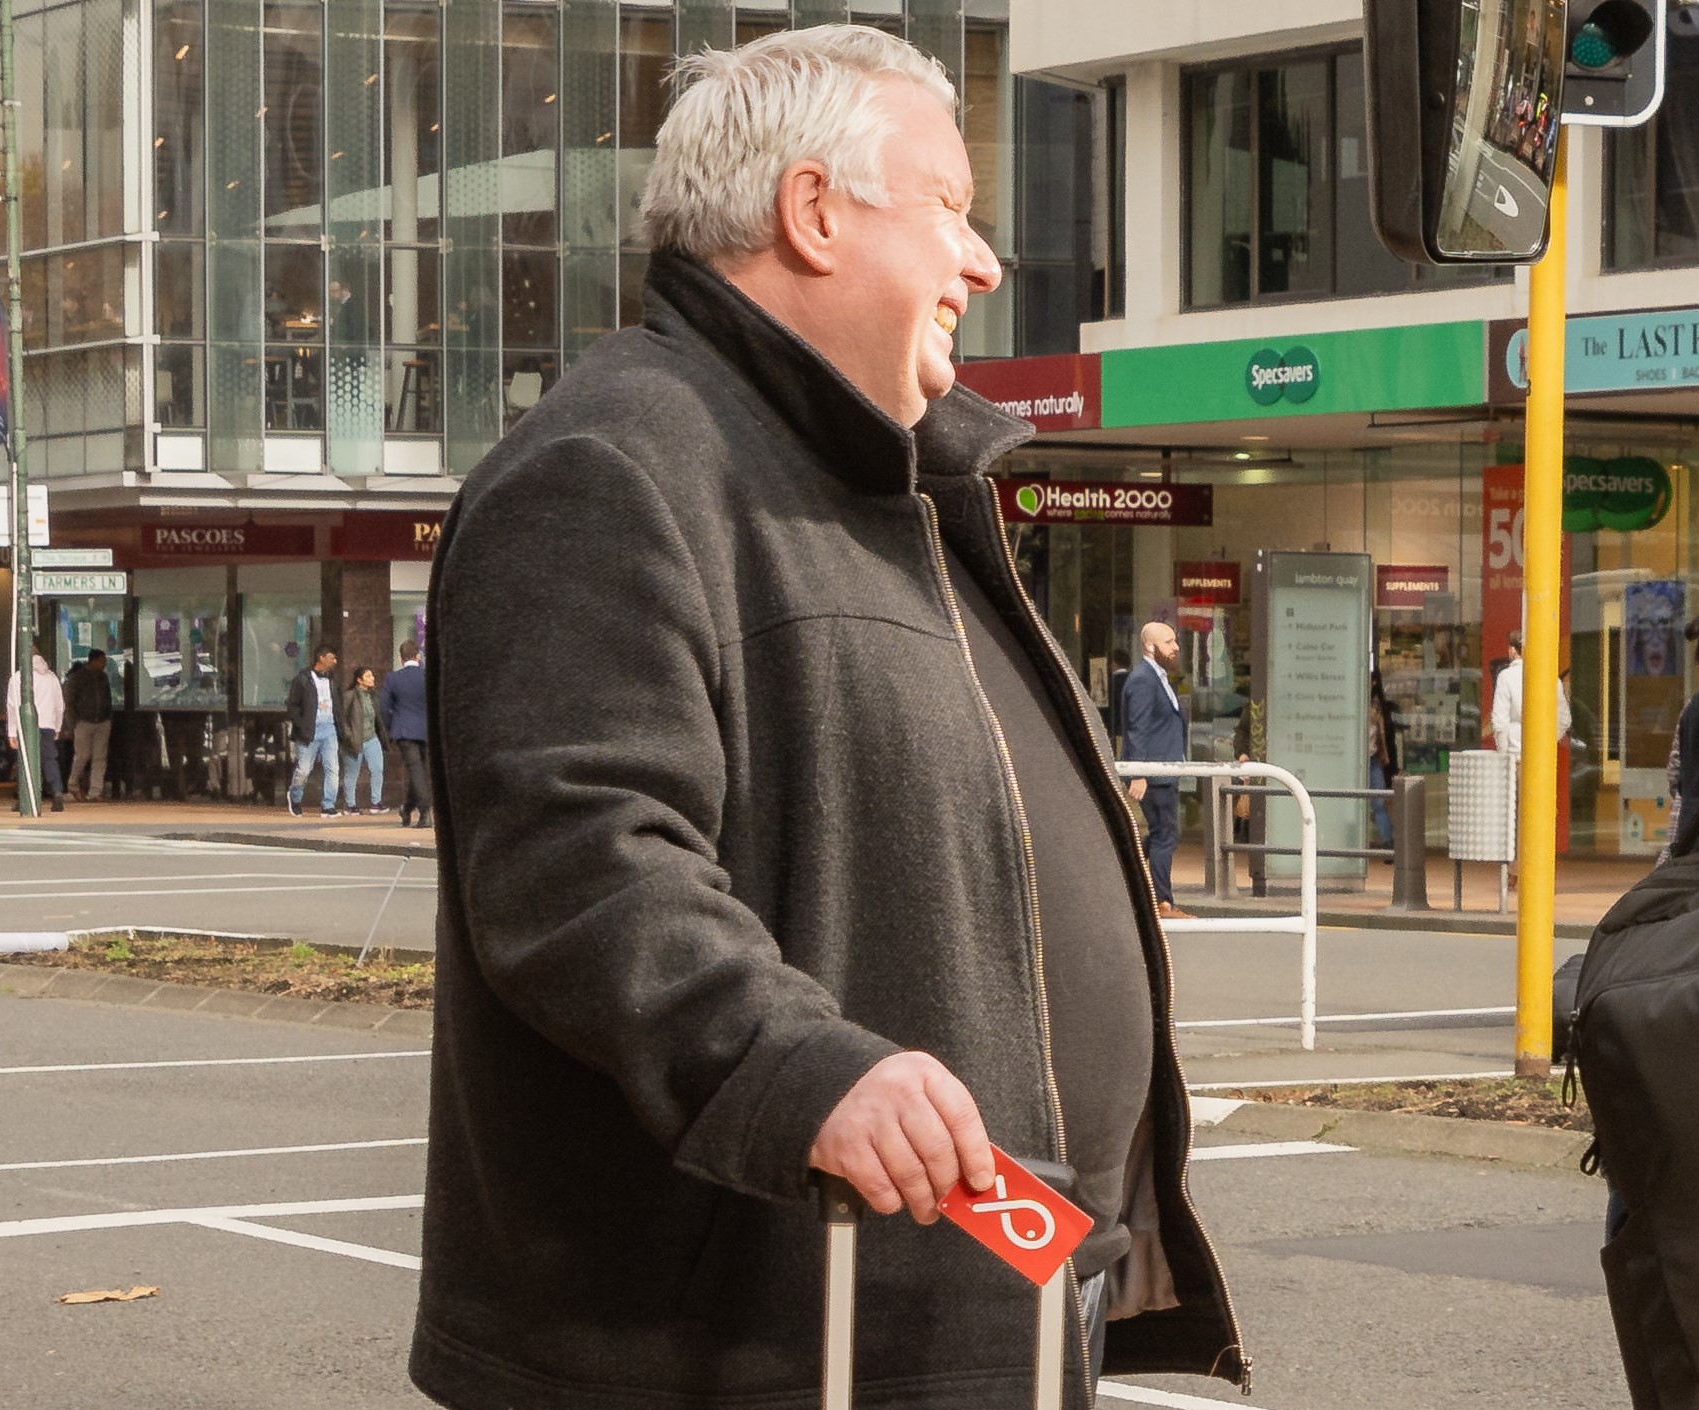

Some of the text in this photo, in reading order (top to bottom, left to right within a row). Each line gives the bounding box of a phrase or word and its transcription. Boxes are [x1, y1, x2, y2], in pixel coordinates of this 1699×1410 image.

[1582, 336, 1607, 356] The
[1618, 324, 1684, 359] LAST
[1252, 364, 1313, 389] Specsavers
[1636, 368, 1666, 382] SHOES
[1035, 391, 1084, 417] naturally
[1046, 487, 1172, 509] Health 2000
[1047, 508, 1072, 519] where
[1105, 510, 1133, 519] comes
[1136, 509, 1171, 521] naturally
[156, 528, 245, 545] PASCOES
[42, 575, 116, 588] FARMERS LN
[1182, 578, 1232, 589] SUPPLEMENTS
[1294, 572, 1359, 587] lambton quay
[1386, 581, 1440, 592] SUPPLEMENTS
